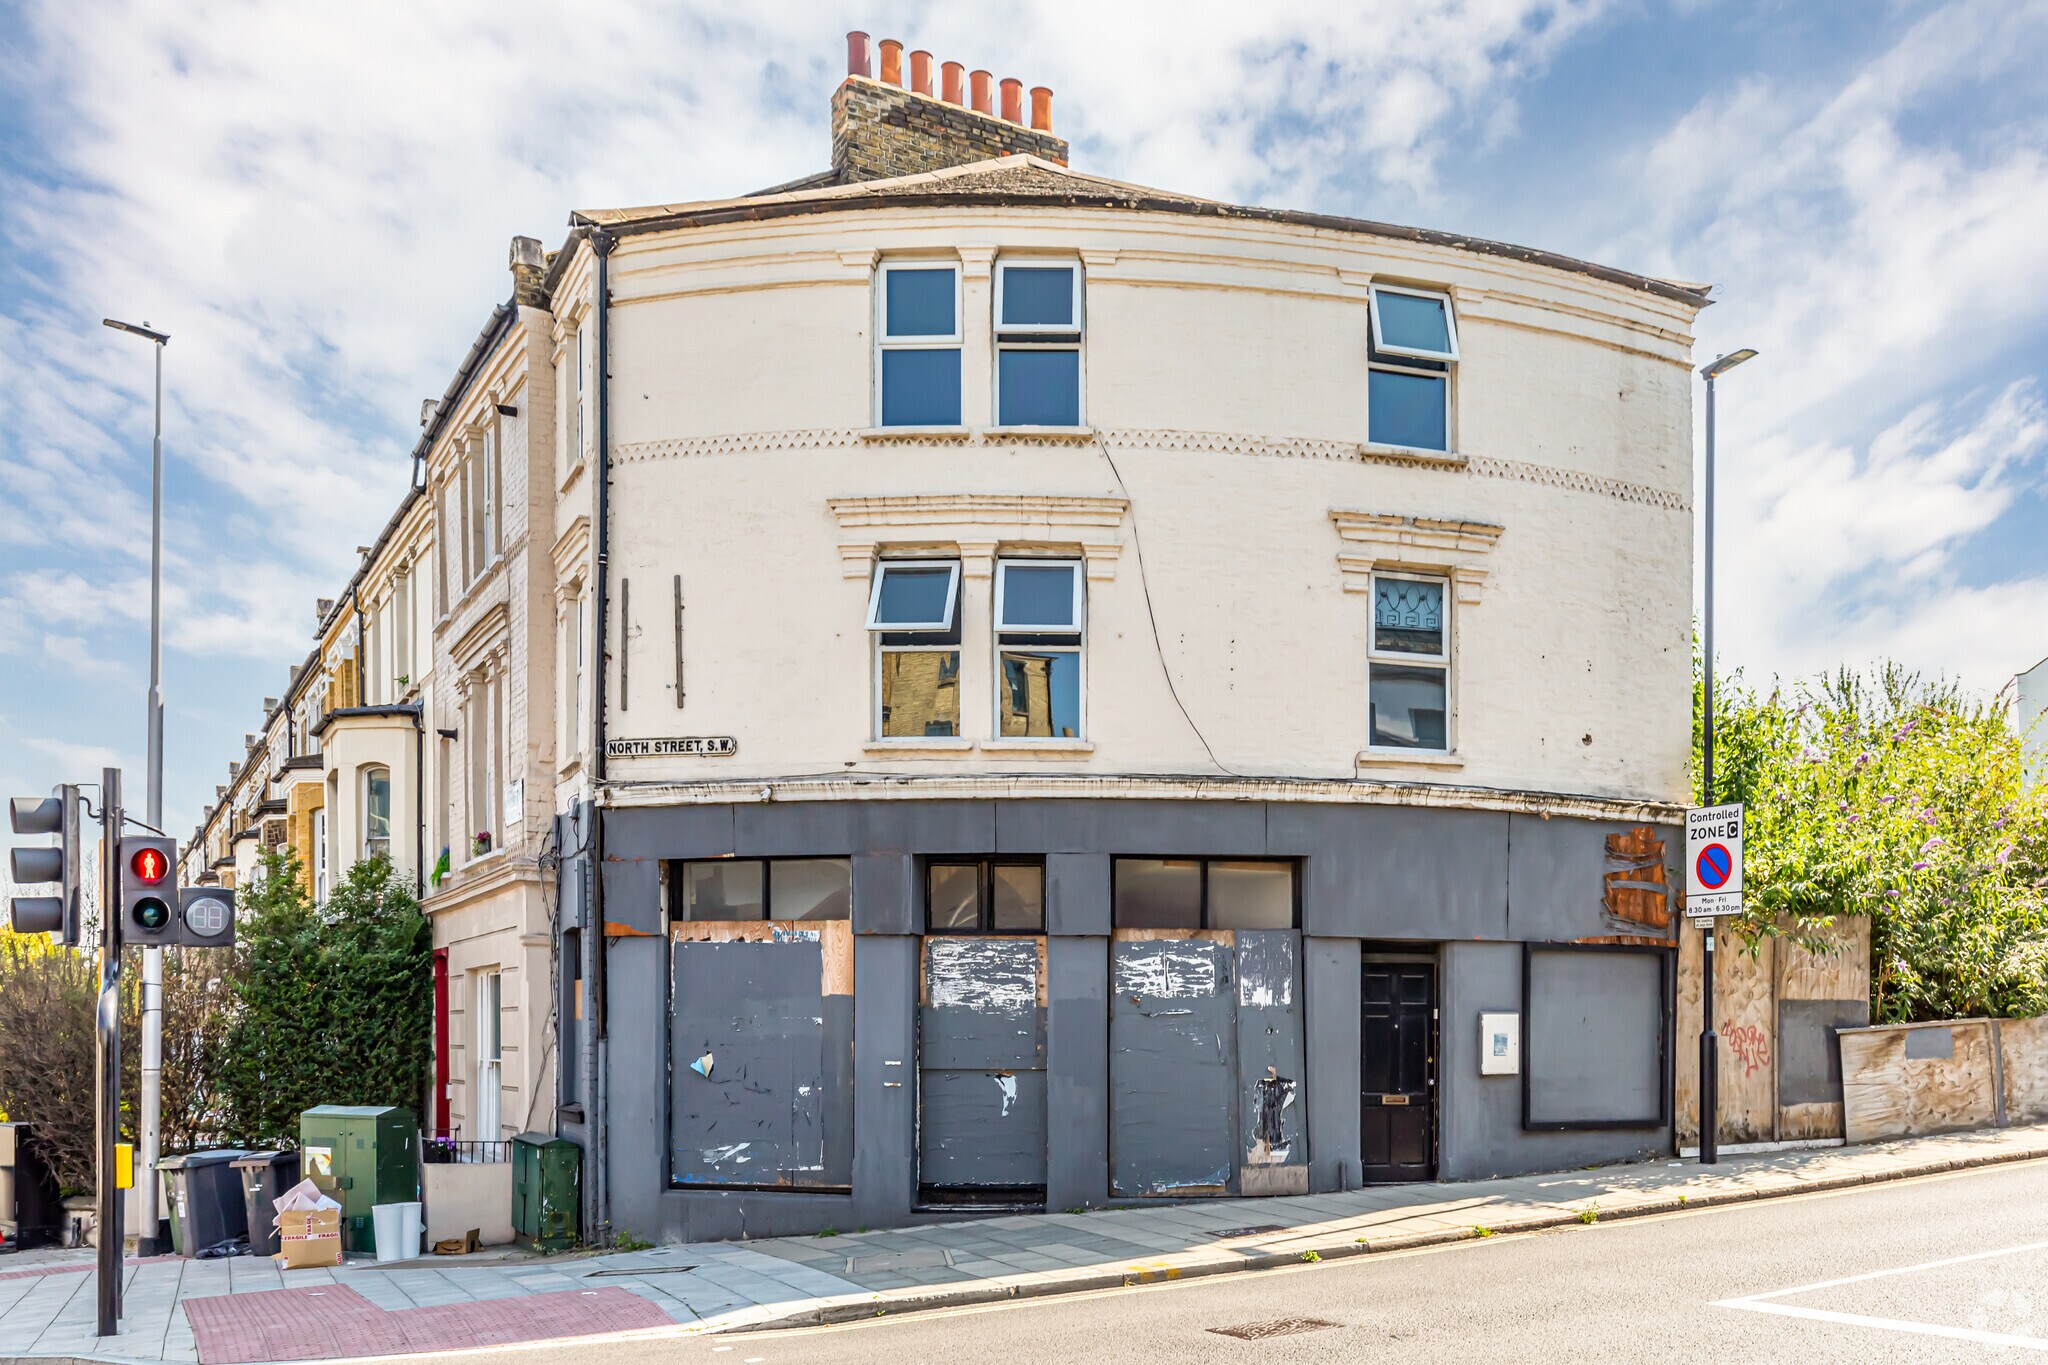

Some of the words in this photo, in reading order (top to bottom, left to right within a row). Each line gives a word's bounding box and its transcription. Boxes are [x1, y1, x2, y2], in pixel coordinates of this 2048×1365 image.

[608, 741, 649, 754] NORTH
[655, 740, 703, 753] STREET,
[1690, 808, 1739, 823] Controlled
[1690, 825, 1725, 840] ZONE
[1728, 822, 1738, 838] C
[1688, 906, 1702, 914] 8.30
[1716, 904, 1730, 912] 6.30
